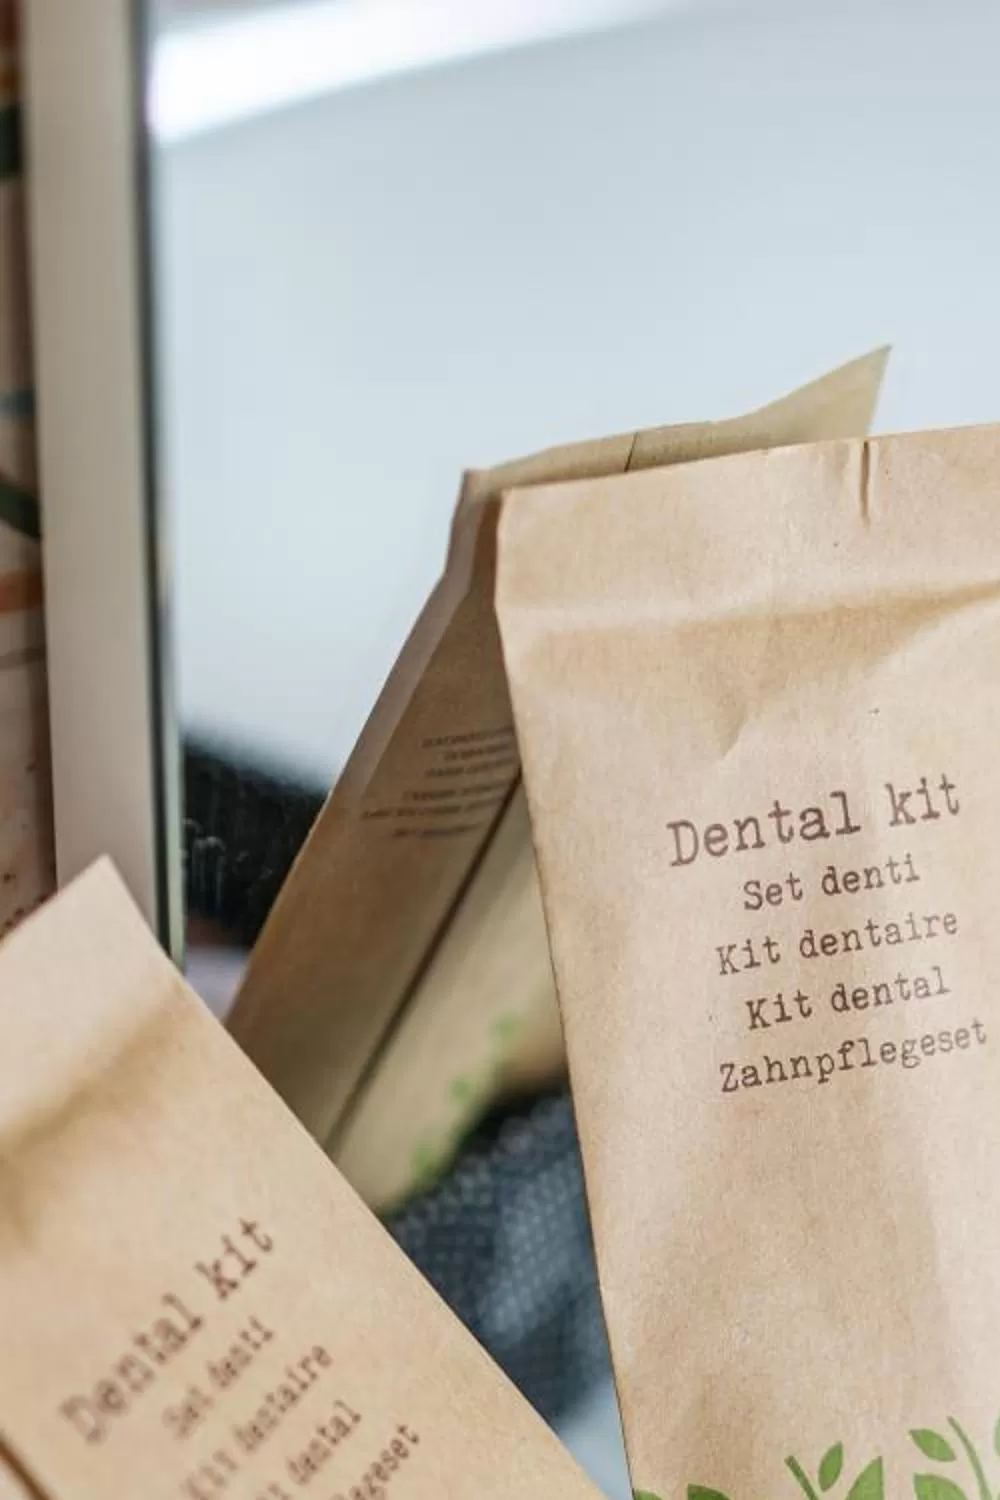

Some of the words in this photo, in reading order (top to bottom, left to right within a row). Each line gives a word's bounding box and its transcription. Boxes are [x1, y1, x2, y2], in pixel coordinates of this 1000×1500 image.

[666, 791, 861, 867] Dental
[885, 773, 961, 827] kit
[743, 871, 803, 911] Set
[821, 853, 920, 896] denti
[715, 936, 781, 976] Kit
[799, 911, 959, 959] dentaire
[745, 989, 812, 1031] Kit
[830, 965, 952, 1013] dental
[719, 1018, 988, 1094] Zahnpflegeset
[57, 1292, 205, 1445] Dental
[194, 1217, 274, 1301] kit
[232, 1345, 334, 1452] dentaire
[284, 1399, 363, 1485] dental
